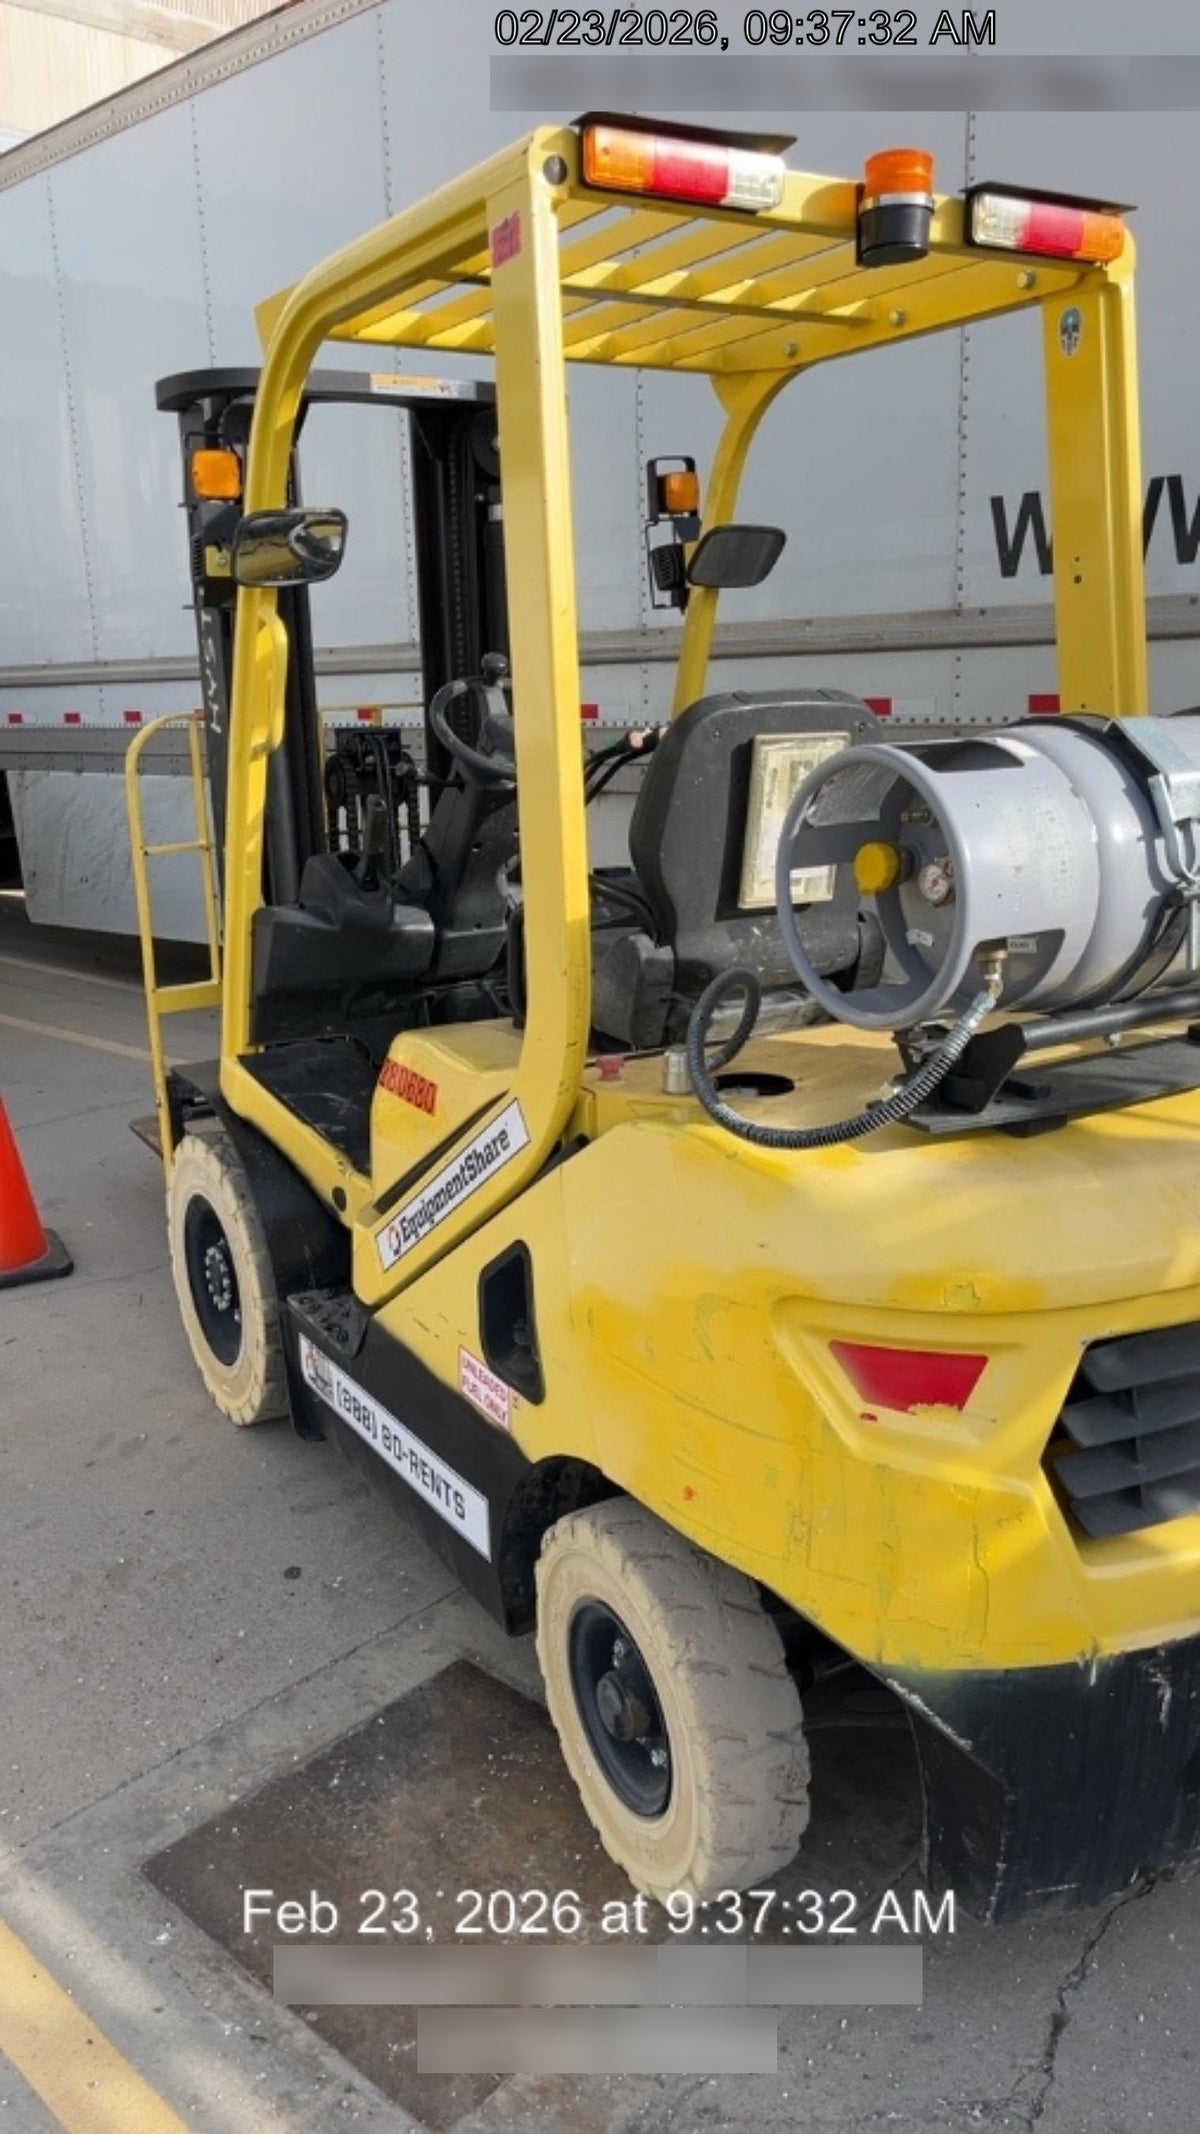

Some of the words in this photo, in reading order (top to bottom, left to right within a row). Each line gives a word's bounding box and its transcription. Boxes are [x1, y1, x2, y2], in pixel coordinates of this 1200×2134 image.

[399, 1127, 511, 1243] EquipmentShare
[462, 1356, 506, 1402] UNLEADED
[462, 1375, 482, 1403] FUEL
[484, 1393, 506, 1424] ONLY
[336, 1380, 378, 1440] (888)
[381, 1424, 466, 1520] 80-RENTS
